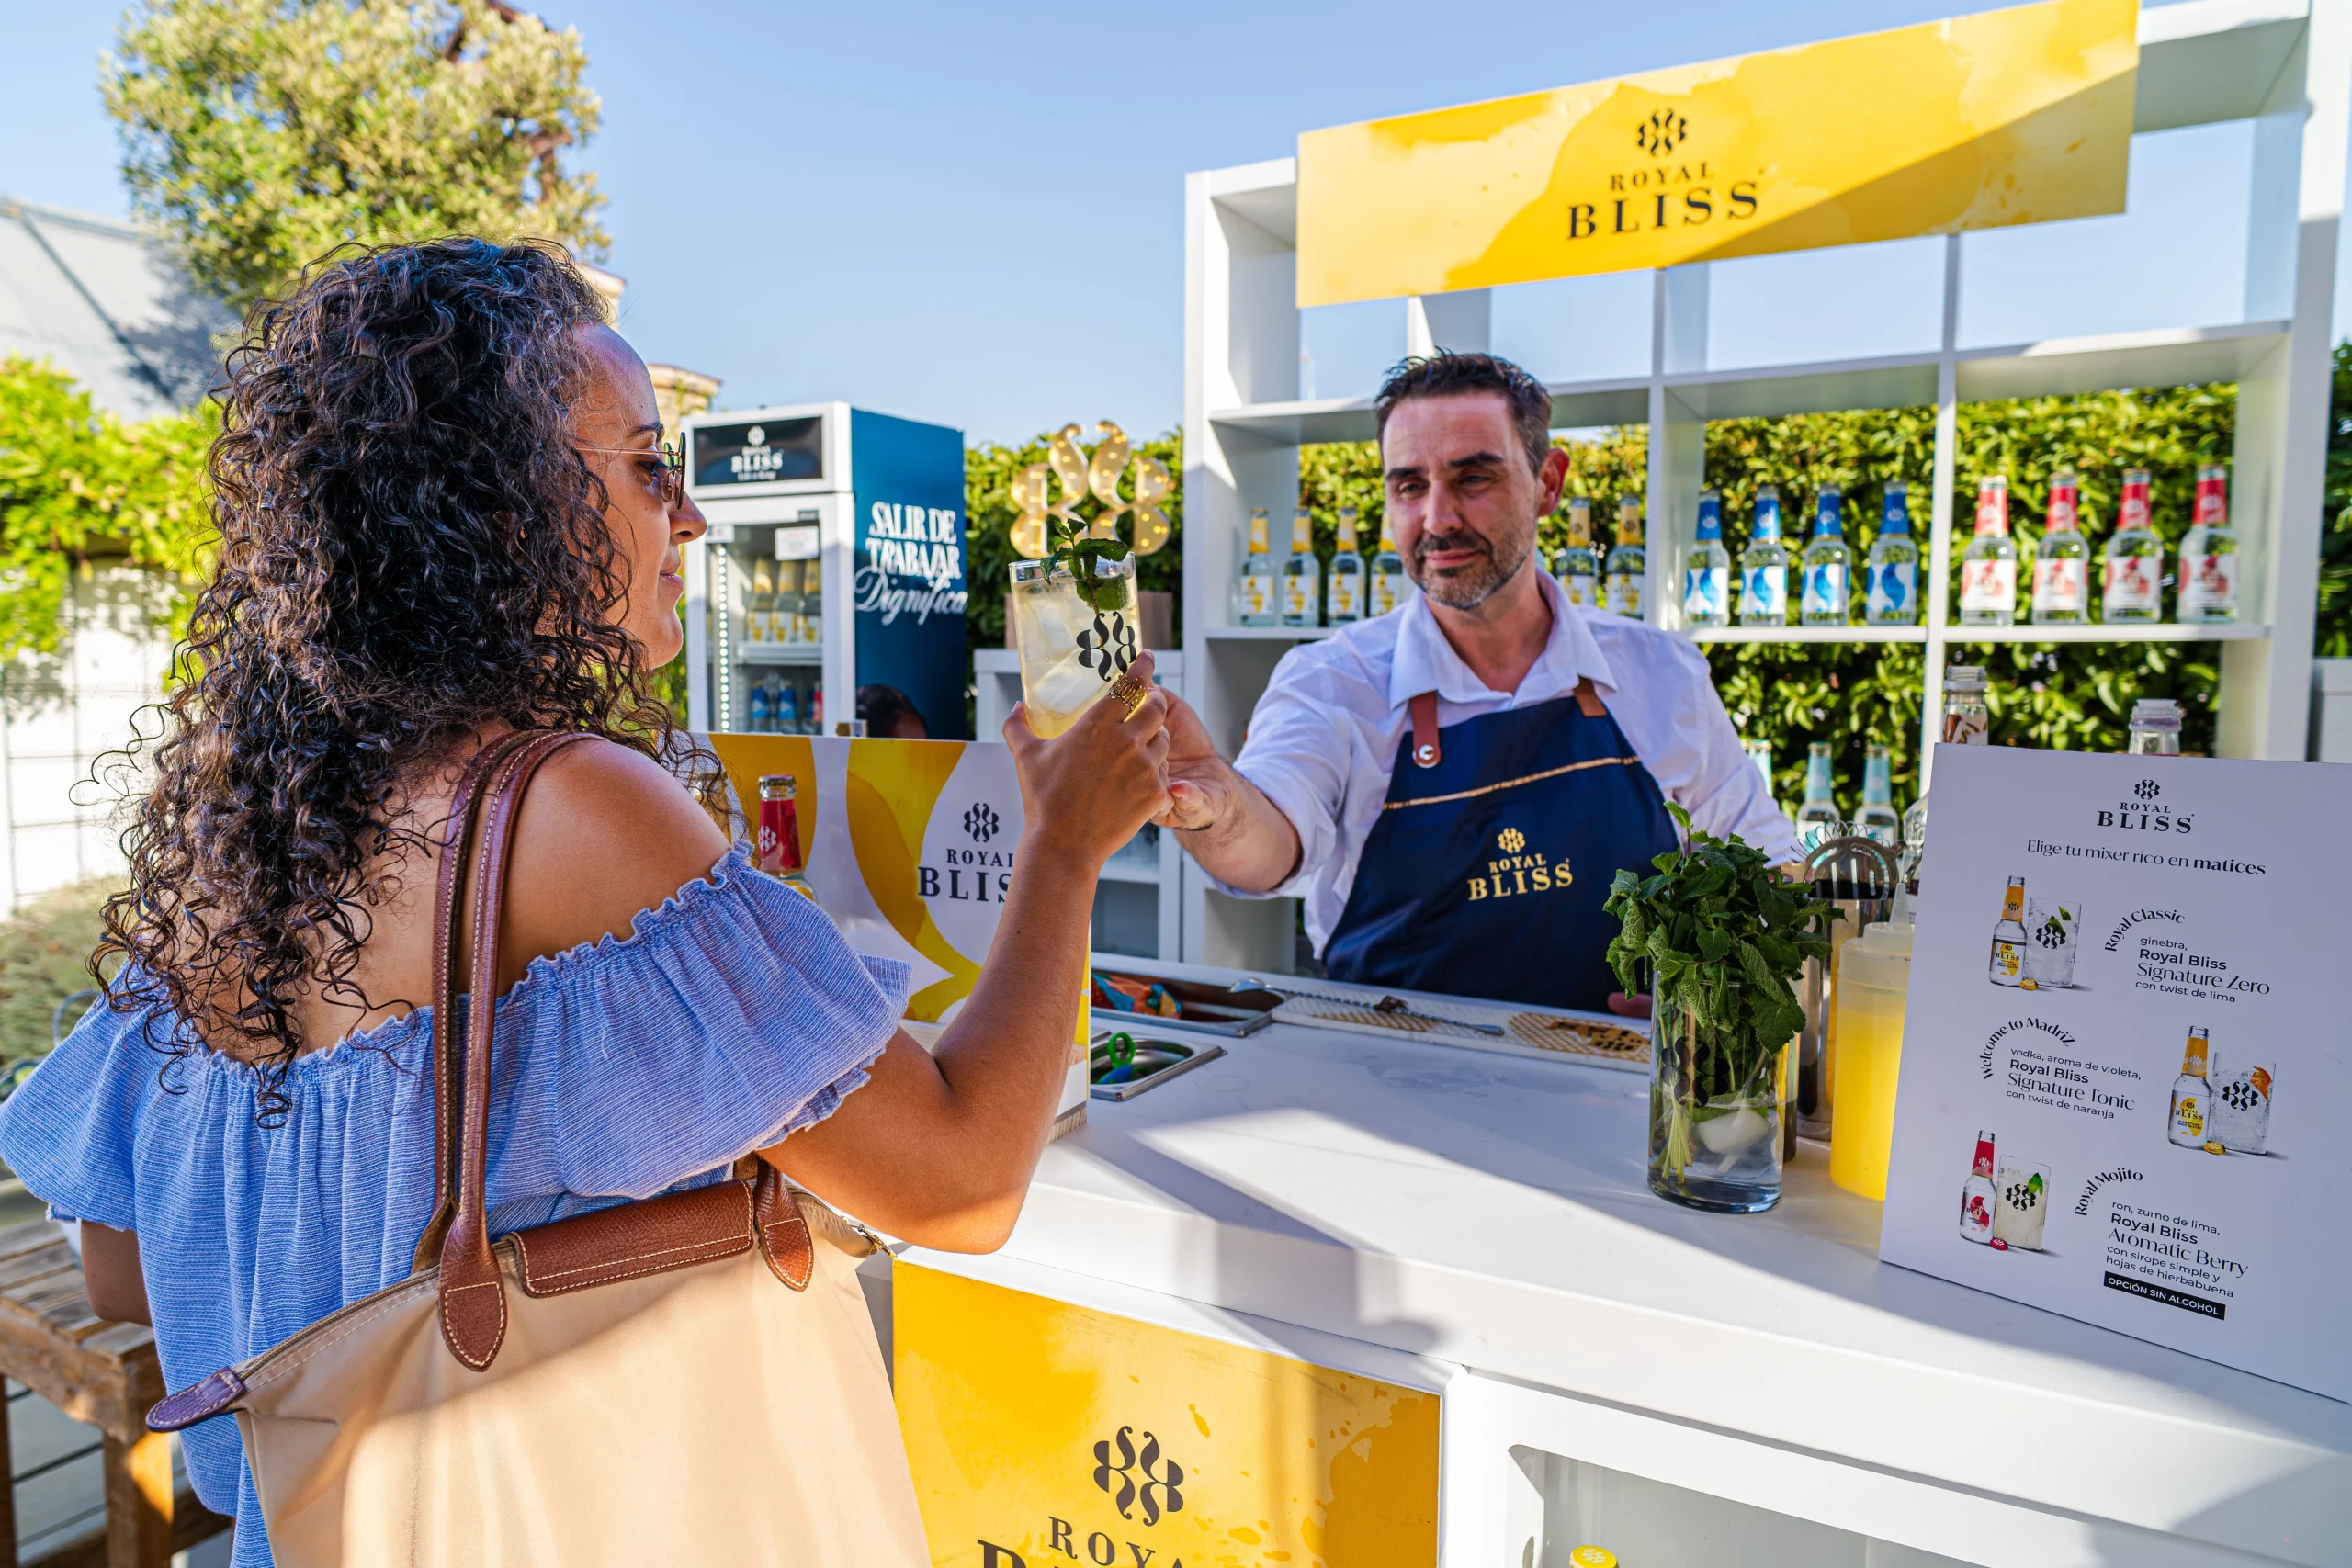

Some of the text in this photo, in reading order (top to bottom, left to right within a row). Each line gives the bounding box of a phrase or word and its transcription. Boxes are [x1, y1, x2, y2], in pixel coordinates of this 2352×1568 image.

[1611, 161, 1714, 192] ROYAL
[1566, 180, 1758, 241] BLISS
[868, 501, 957, 545] SALIR DE
[865, 537, 962, 580] TRABAJAR
[854, 566, 969, 626] Dignifica
[2097, 810, 2192, 834] BLISS
[2120, 802, 2171, 814] ROYAL
[1488, 853, 1546, 874] ROYAL
[2027, 840, 2267, 875] Elige tu mixer rico en matices
[1467, 863, 1573, 901] BLISS
[2104, 908, 2186, 953] Royal Classic
[2140, 936, 2188, 952] ginebra,
[2139, 948, 2227, 971] Royal Bliss
[2135, 981, 2236, 1003] con twist de lima
[2136, 962, 2270, 995] Signature Zero
[1980, 1026, 2009, 1080] Welcome
[2008, 1020, 2024, 1031] to
[2010, 1048, 2142, 1080] vodka, aroma de violeta,
[2009, 1059, 2089, 1084] Royal Bliss
[2006, 1090, 2115, 1119] con twist de naranja
[2007, 1072, 2135, 1111] Signature Tonic
[2075, 1168, 2143, 1216] Royal Mojito
[2110, 1213, 2199, 1245] Royal Bliss
[2111, 1201, 2221, 1236] ron, zumo de lima,
[2107, 1245, 2221, 1283] con sirope simple y
[2108, 1227, 2248, 1279] Aromatic Berry
[2106, 1255, 2234, 1298] hojas de hierbabuena
[2108, 1277, 2220, 1315] OPCIÓN SIN ALCOHOL
